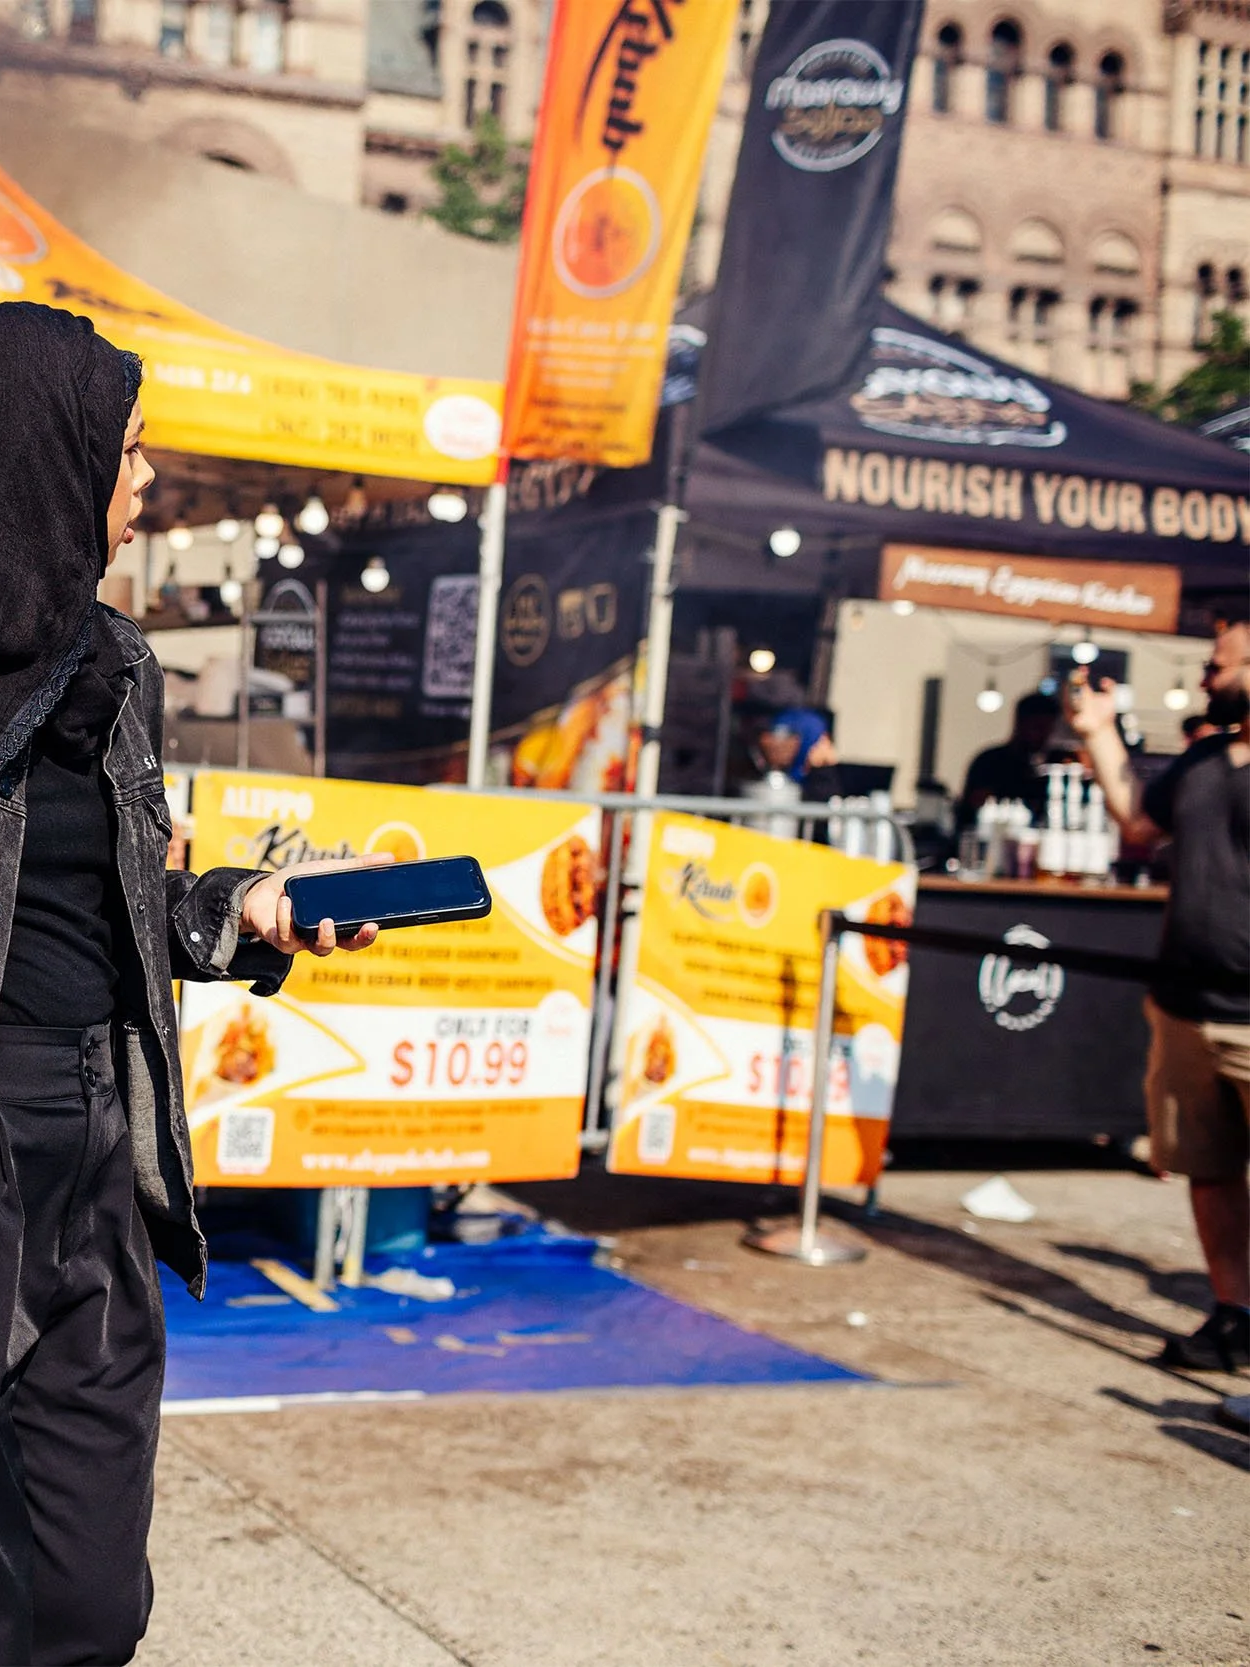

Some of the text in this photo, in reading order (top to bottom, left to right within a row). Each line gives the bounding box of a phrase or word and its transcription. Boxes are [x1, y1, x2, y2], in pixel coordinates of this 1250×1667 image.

[823, 448, 1023, 521] NOURISH
[1032, 472, 1145, 534] YOUR
[221, 785, 314, 822] ALEPPO
[436, 1017, 487, 1037] ONLY
[495, 1015, 532, 1037] FOR
[391, 1039, 529, 1088] $10.99
